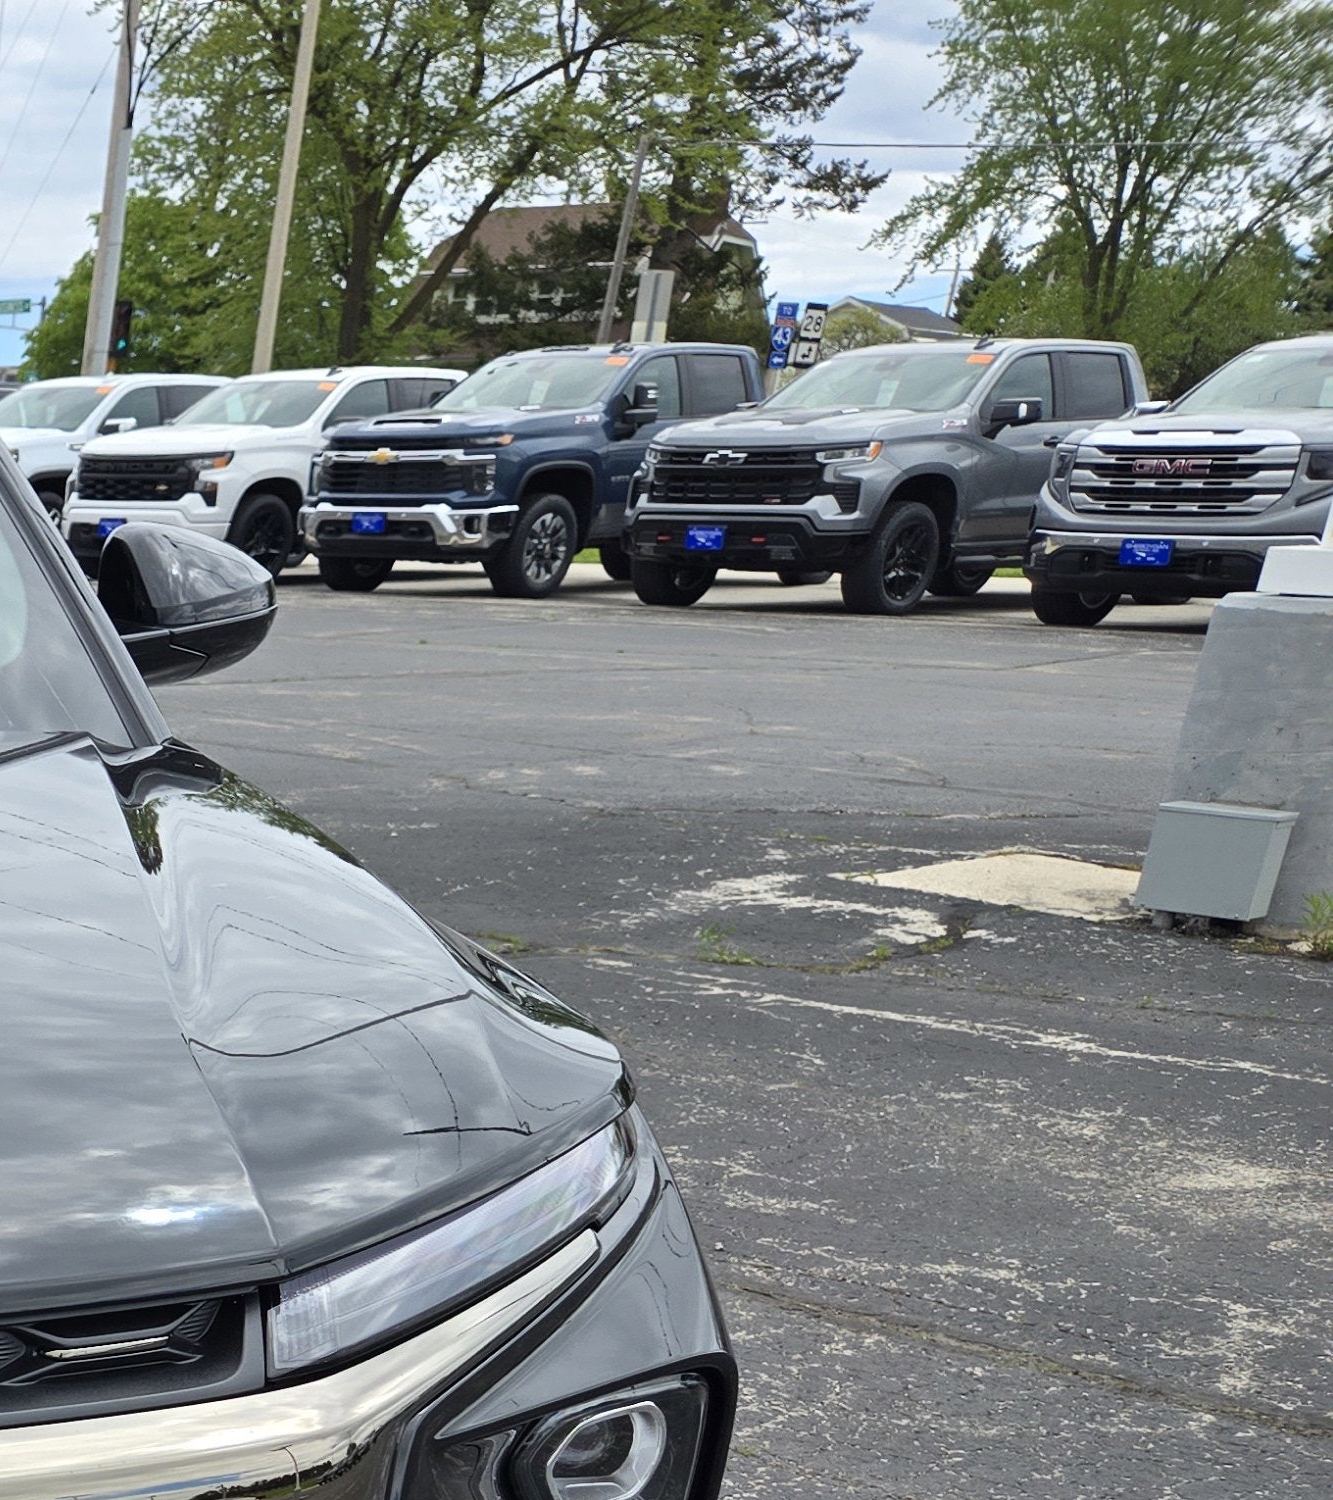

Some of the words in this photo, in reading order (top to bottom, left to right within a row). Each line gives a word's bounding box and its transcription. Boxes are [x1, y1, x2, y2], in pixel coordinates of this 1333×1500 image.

[803, 315, 824, 333] 28
[772, 327, 791, 345] 43
[1132, 459, 1212, 474] GMC
